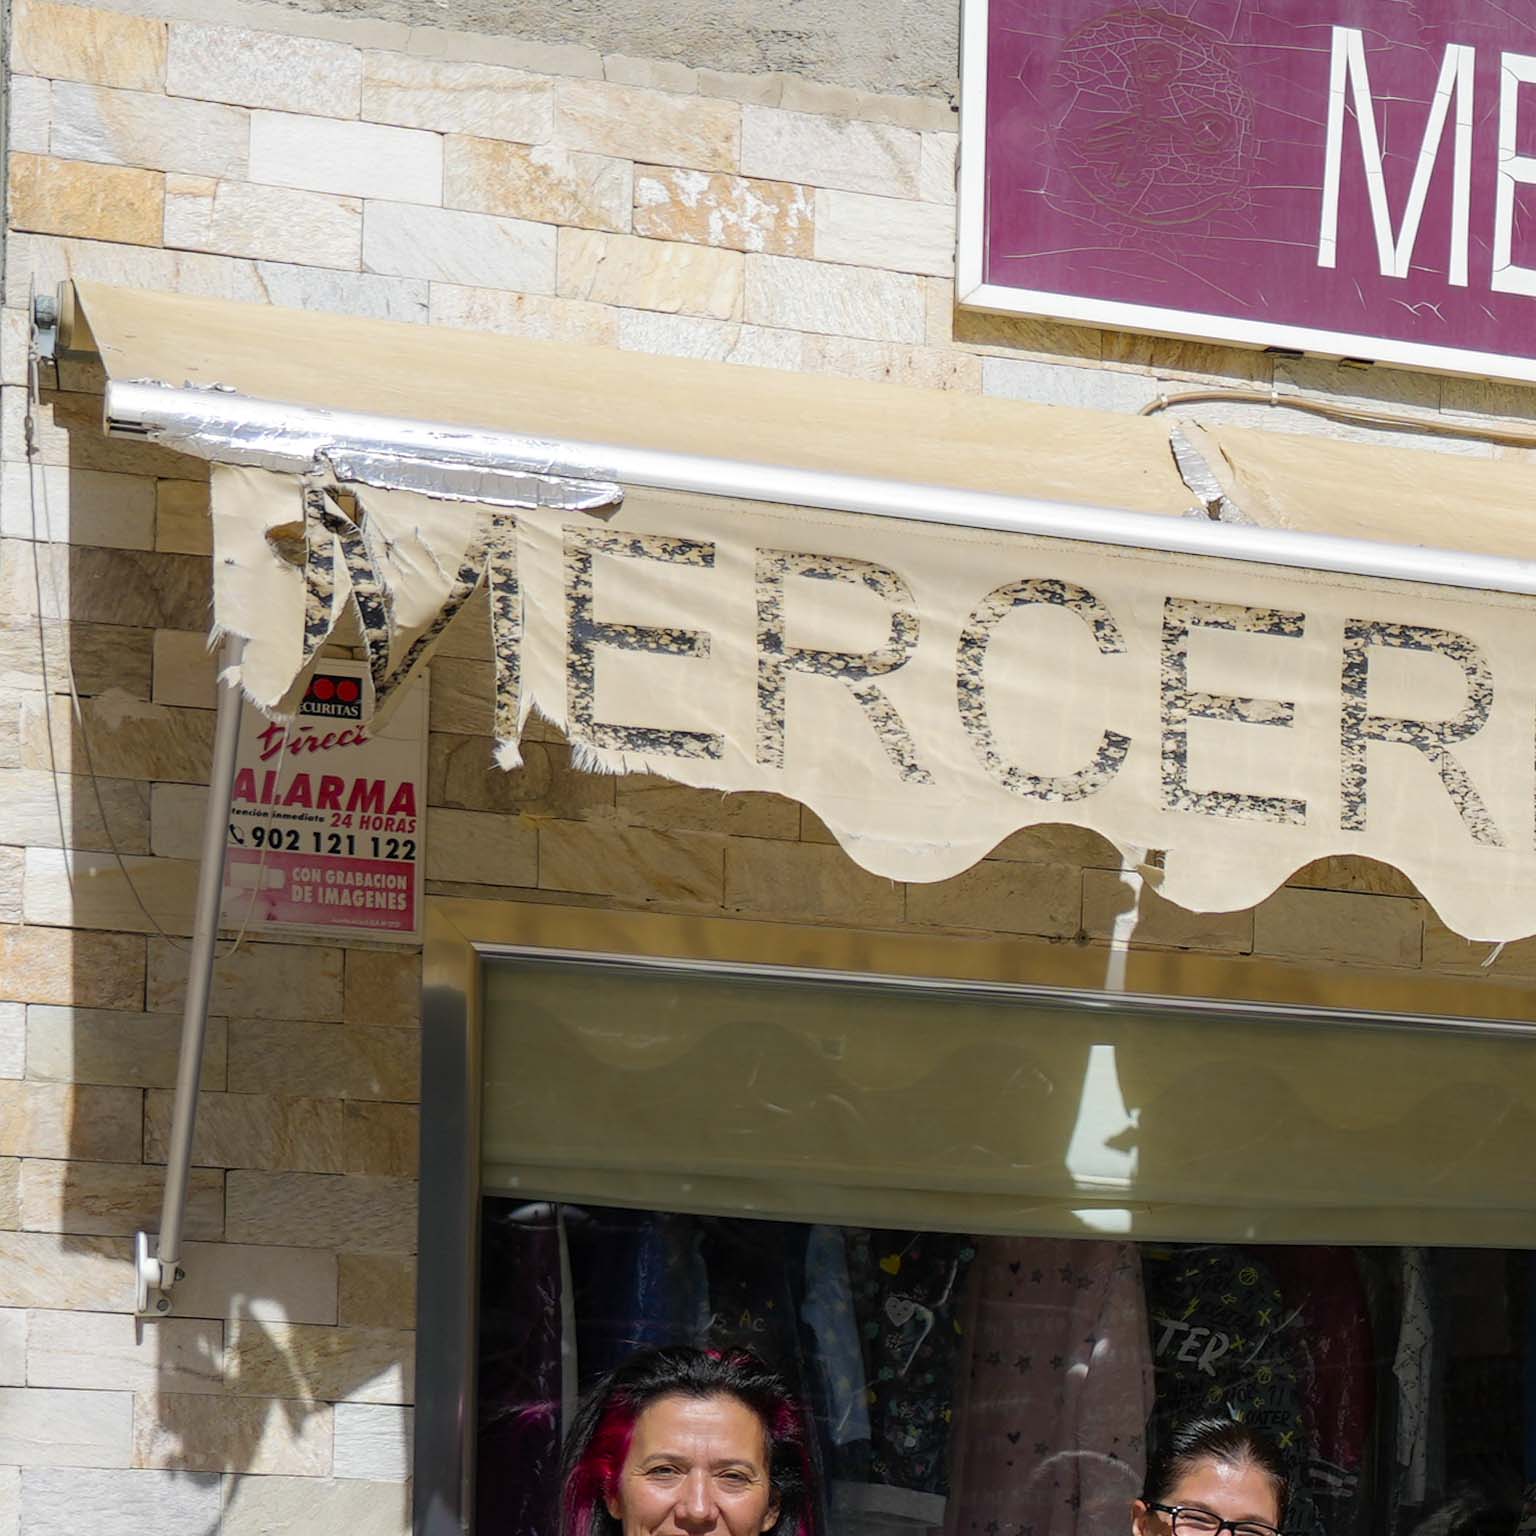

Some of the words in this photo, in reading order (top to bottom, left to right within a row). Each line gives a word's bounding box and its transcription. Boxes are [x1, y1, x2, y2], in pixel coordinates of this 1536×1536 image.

[232, 767, 417, 818] ALARMA
[330, 812, 353, 829] 24
[359, 815, 417, 834] HORAS
[251, 826, 300, 851] 902
[312, 831, 356, 855] 121
[371, 836, 417, 861] 122
[292, 867, 321, 882] CON
[325, 869, 408, 890] GRABACION
[292, 886, 314, 903] DE
[318, 887, 408, 911] IMAGENES
